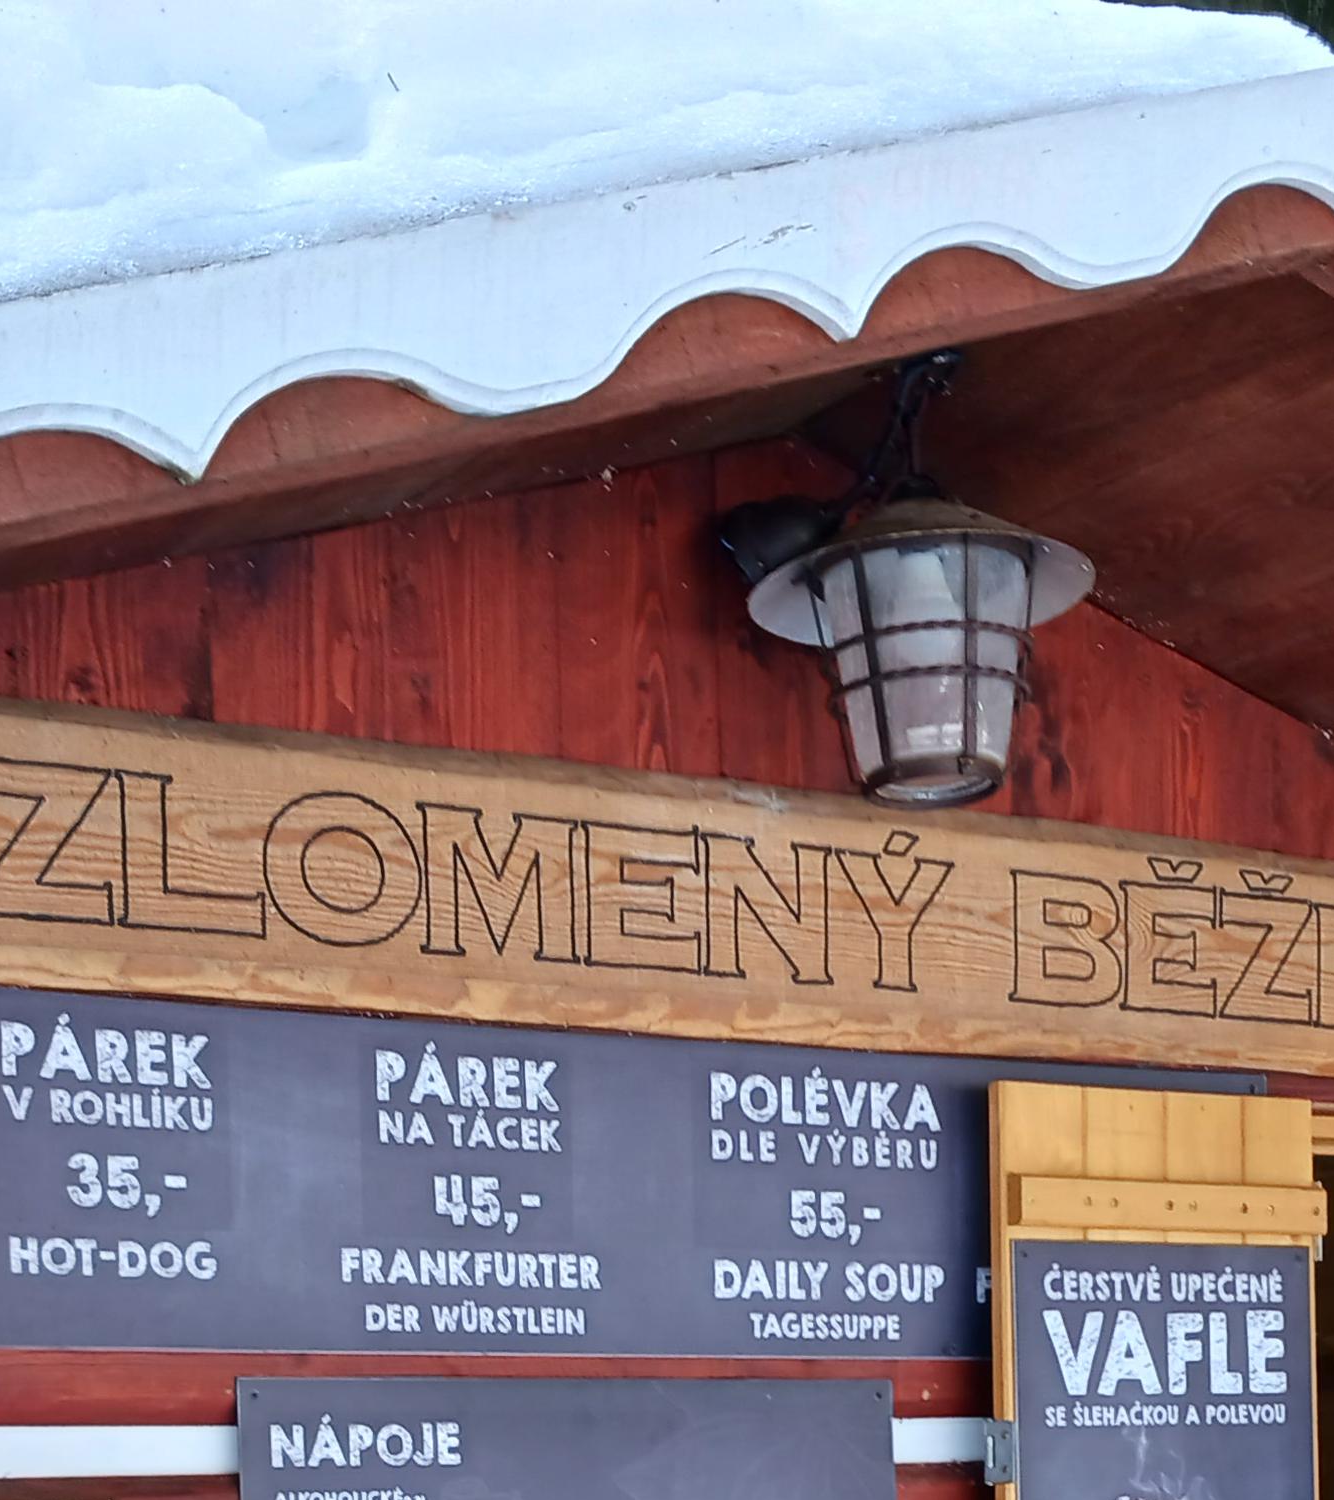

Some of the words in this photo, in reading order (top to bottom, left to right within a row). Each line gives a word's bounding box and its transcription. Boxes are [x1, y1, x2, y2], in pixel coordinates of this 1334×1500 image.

[0, 1013, 213, 1090] PÁREK
[375, 1041, 560, 1113] PÁREK
[709, 1065, 942, 1133] POLÉVKA
[1, 1085, 33, 1124] V
[51, 1087, 215, 1134] ROHLÍKU
[379, 1110, 435, 1147] NA
[447, 1109, 562, 1155] TÁCEK
[711, 1128, 778, 1163] DLE
[797, 1127, 939, 1171] VÝBĚRU
[66, 1153, 188, 1218] 35,-
[433, 1175, 542, 1235] 45,-
[788, 1189, 882, 1246] 55,-
[8, 1236, 218, 1281] HOT-DOG
[340, 1247, 603, 1291] FRANKFURTER
[713, 1258, 829, 1301] DAILY
[844, 1260, 946, 1304] SOUP
[365, 1304, 423, 1335] DER
[432, 1299, 587, 1337] WÜRSTLEIN
[749, 1311, 902, 1341] TAGESSUPPE
[1042, 1309, 1288, 1396] VAFLE
[1045, 1405, 1067, 1427] SE
[1072, 1400, 1179, 1427] ŠLEHAČKOU
[1185, 1404, 1201, 1425] A
[1205, 1402, 1286, 1425] POLEVOU
[269, 1413, 462, 1468] NÁPOJE
